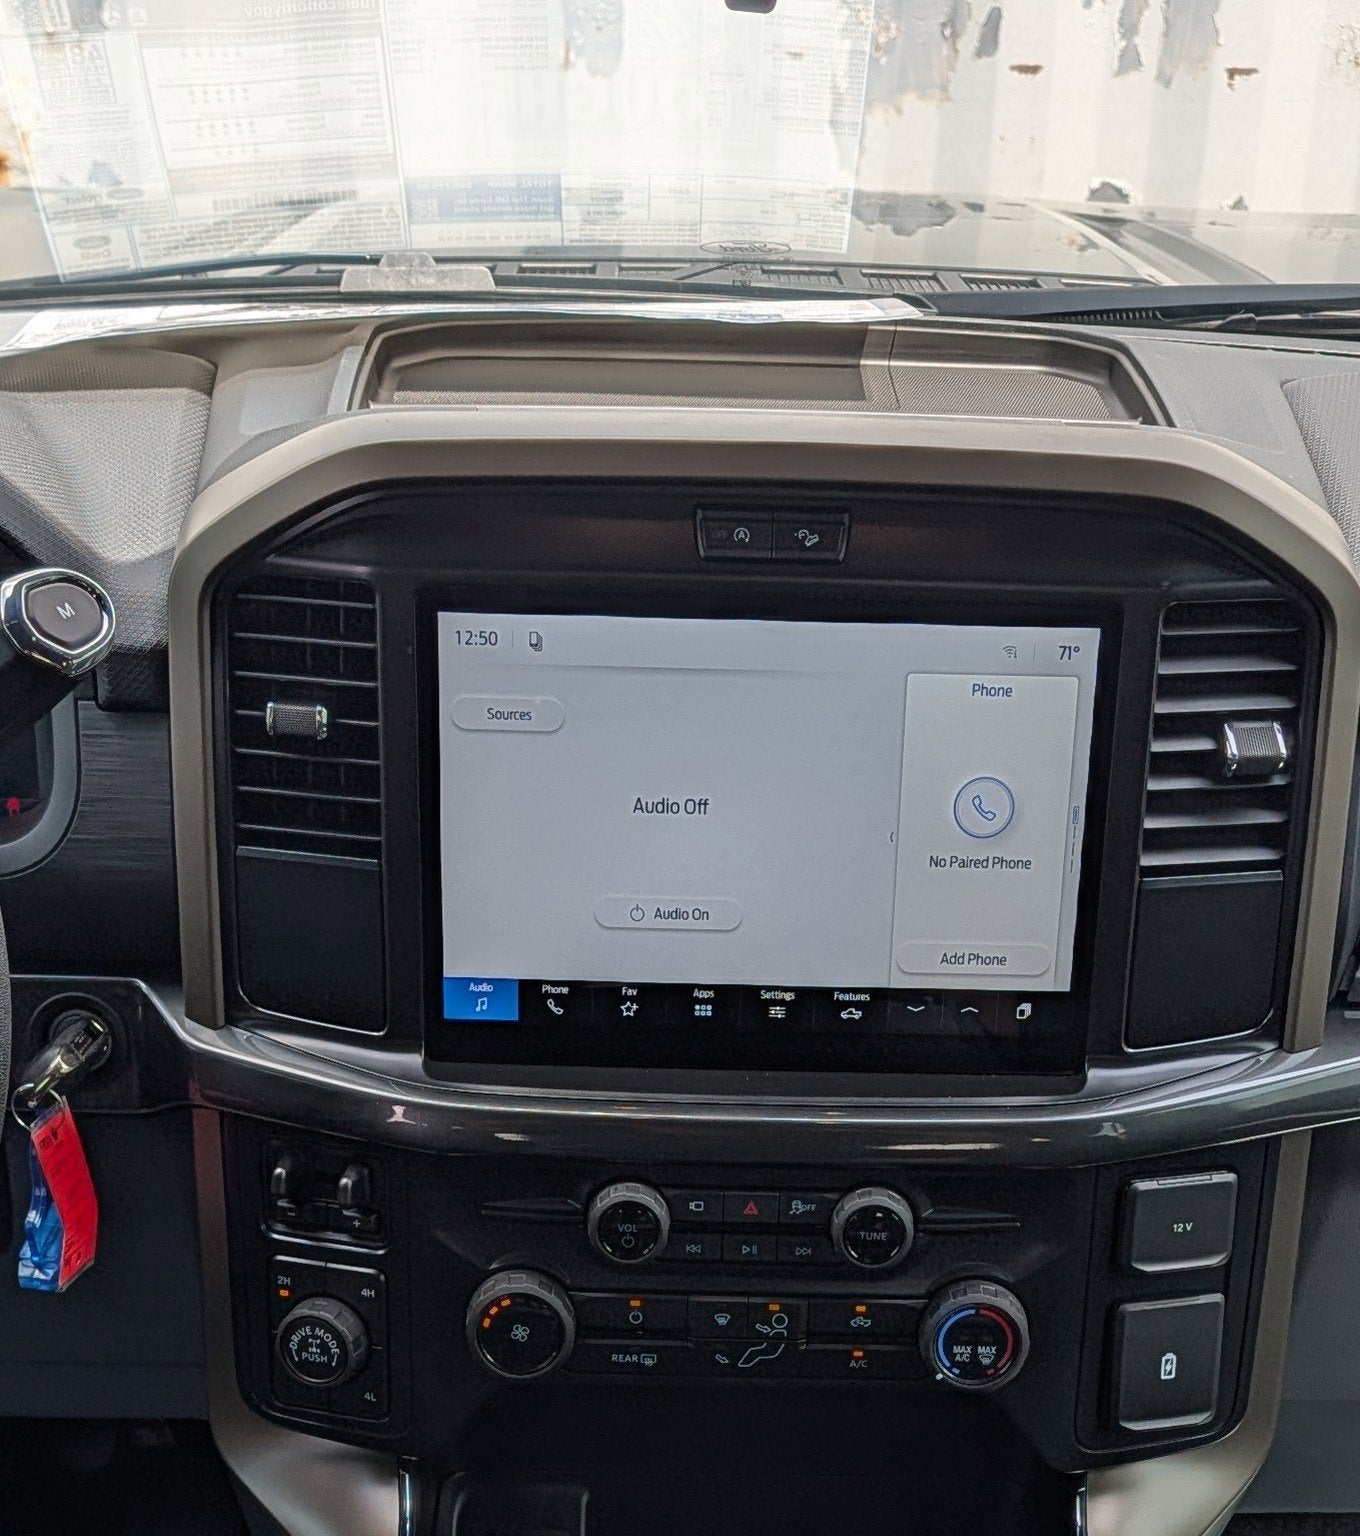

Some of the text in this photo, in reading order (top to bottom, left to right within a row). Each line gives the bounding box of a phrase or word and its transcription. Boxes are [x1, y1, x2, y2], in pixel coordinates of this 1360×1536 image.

[56, 602, 76, 620] M
[454, 630, 499, 648] 12:50
[971, 683, 1013, 699] Phone
[486, 707, 532, 722] Sources
[633, 797, 710, 816] Audio Off
[929, 855, 1032, 871] No Paired Phone
[653, 907, 710, 921] Audio On
[939, 952, 1007, 967] Add Phone
[469, 982, 494, 993] Audio
[541, 984, 569, 995] Phone
[622, 986, 638, 997] Fav
[693, 988, 714, 1000] Apps
[760, 989, 795, 1002] Settings
[833, 991, 871, 1002] Features
[801, 1203, 816, 1212] OFF
[617, 1223, 638, 1233] VOL
[1173, 1222, 1193, 1232] 12 V
[859, 1231, 887, 1242] TUNE
[277, 1276, 291, 1286] 2H
[361, 1289, 375, 1299] 4H
[289, 1326, 340, 1354] DRIVE MODE
[953, 1345, 973, 1354] MAX
[977, 1346, 997, 1354] MAX
[302, 1352, 328, 1364] PUSH
[612, 1354, 638, 1363] REAR
[849, 1359, 868, 1368] A/C
[954, 1354, 971, 1362] A/C
[364, 1392, 377, 1402] 4L
